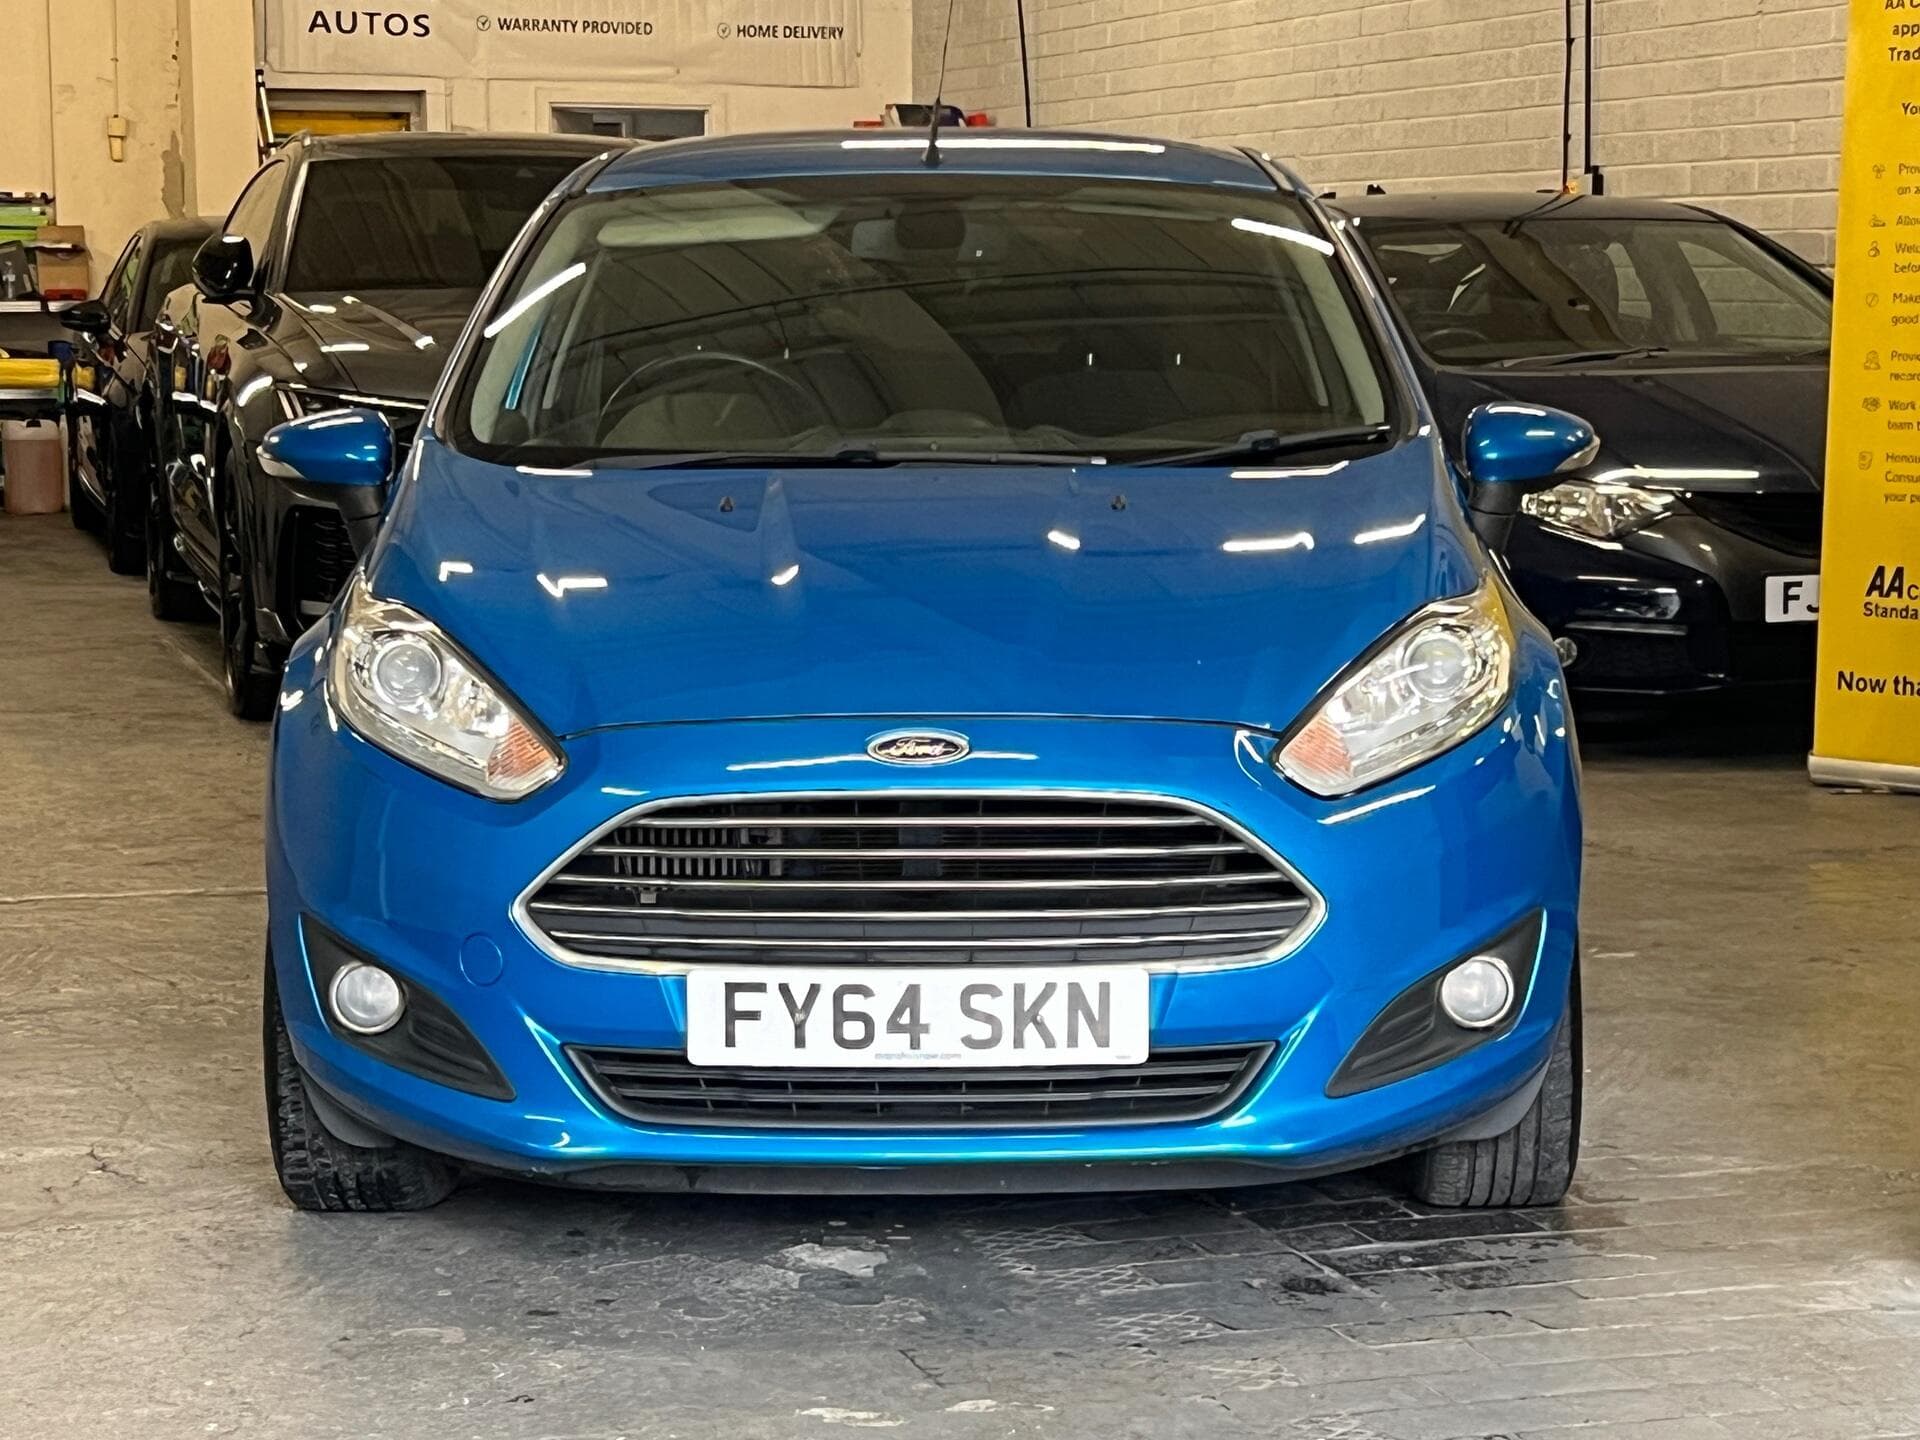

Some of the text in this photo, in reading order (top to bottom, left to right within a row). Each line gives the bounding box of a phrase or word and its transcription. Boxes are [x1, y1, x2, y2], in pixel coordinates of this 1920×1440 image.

[308, 10, 431, 37] AUTOS
[498, 17, 654, 37] WARRANTY PROVIDED
[736, 24, 844, 39] HOME DELIVERY
[1901, 101, 1920, 116] Yo
[1891, 315, 1919, 327] good
[1837, 670, 1887, 694] Now
[878, 738, 956, 756] Ford
[724, 982, 1111, 1050] FY64 SKN
